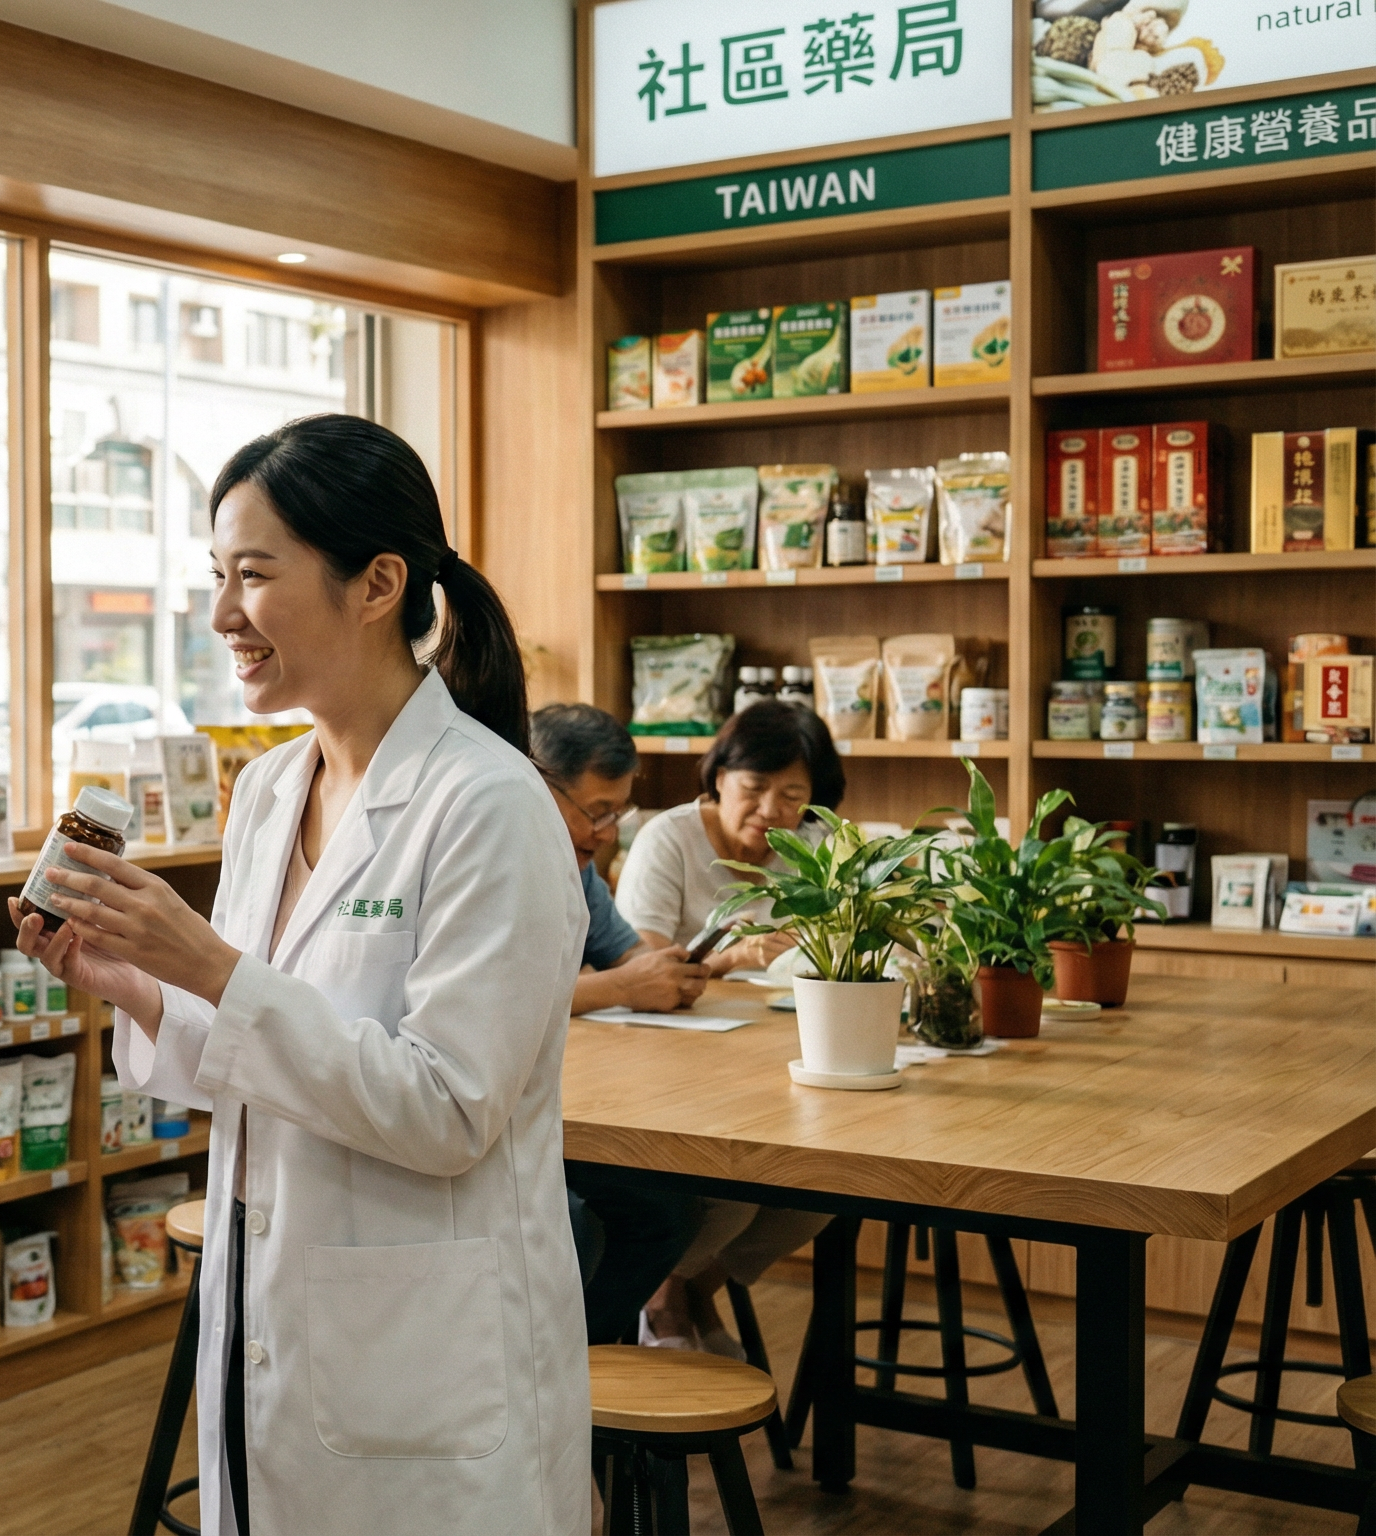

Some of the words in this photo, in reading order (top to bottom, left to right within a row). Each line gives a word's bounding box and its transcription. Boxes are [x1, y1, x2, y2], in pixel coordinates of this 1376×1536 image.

[1257, 0, 1362, 31] natural
[638, 0, 963, 121] 社區藥局
[1156, 96, 1376, 166] 健康營養品
[716, 167, 875, 219] TAIWAN
